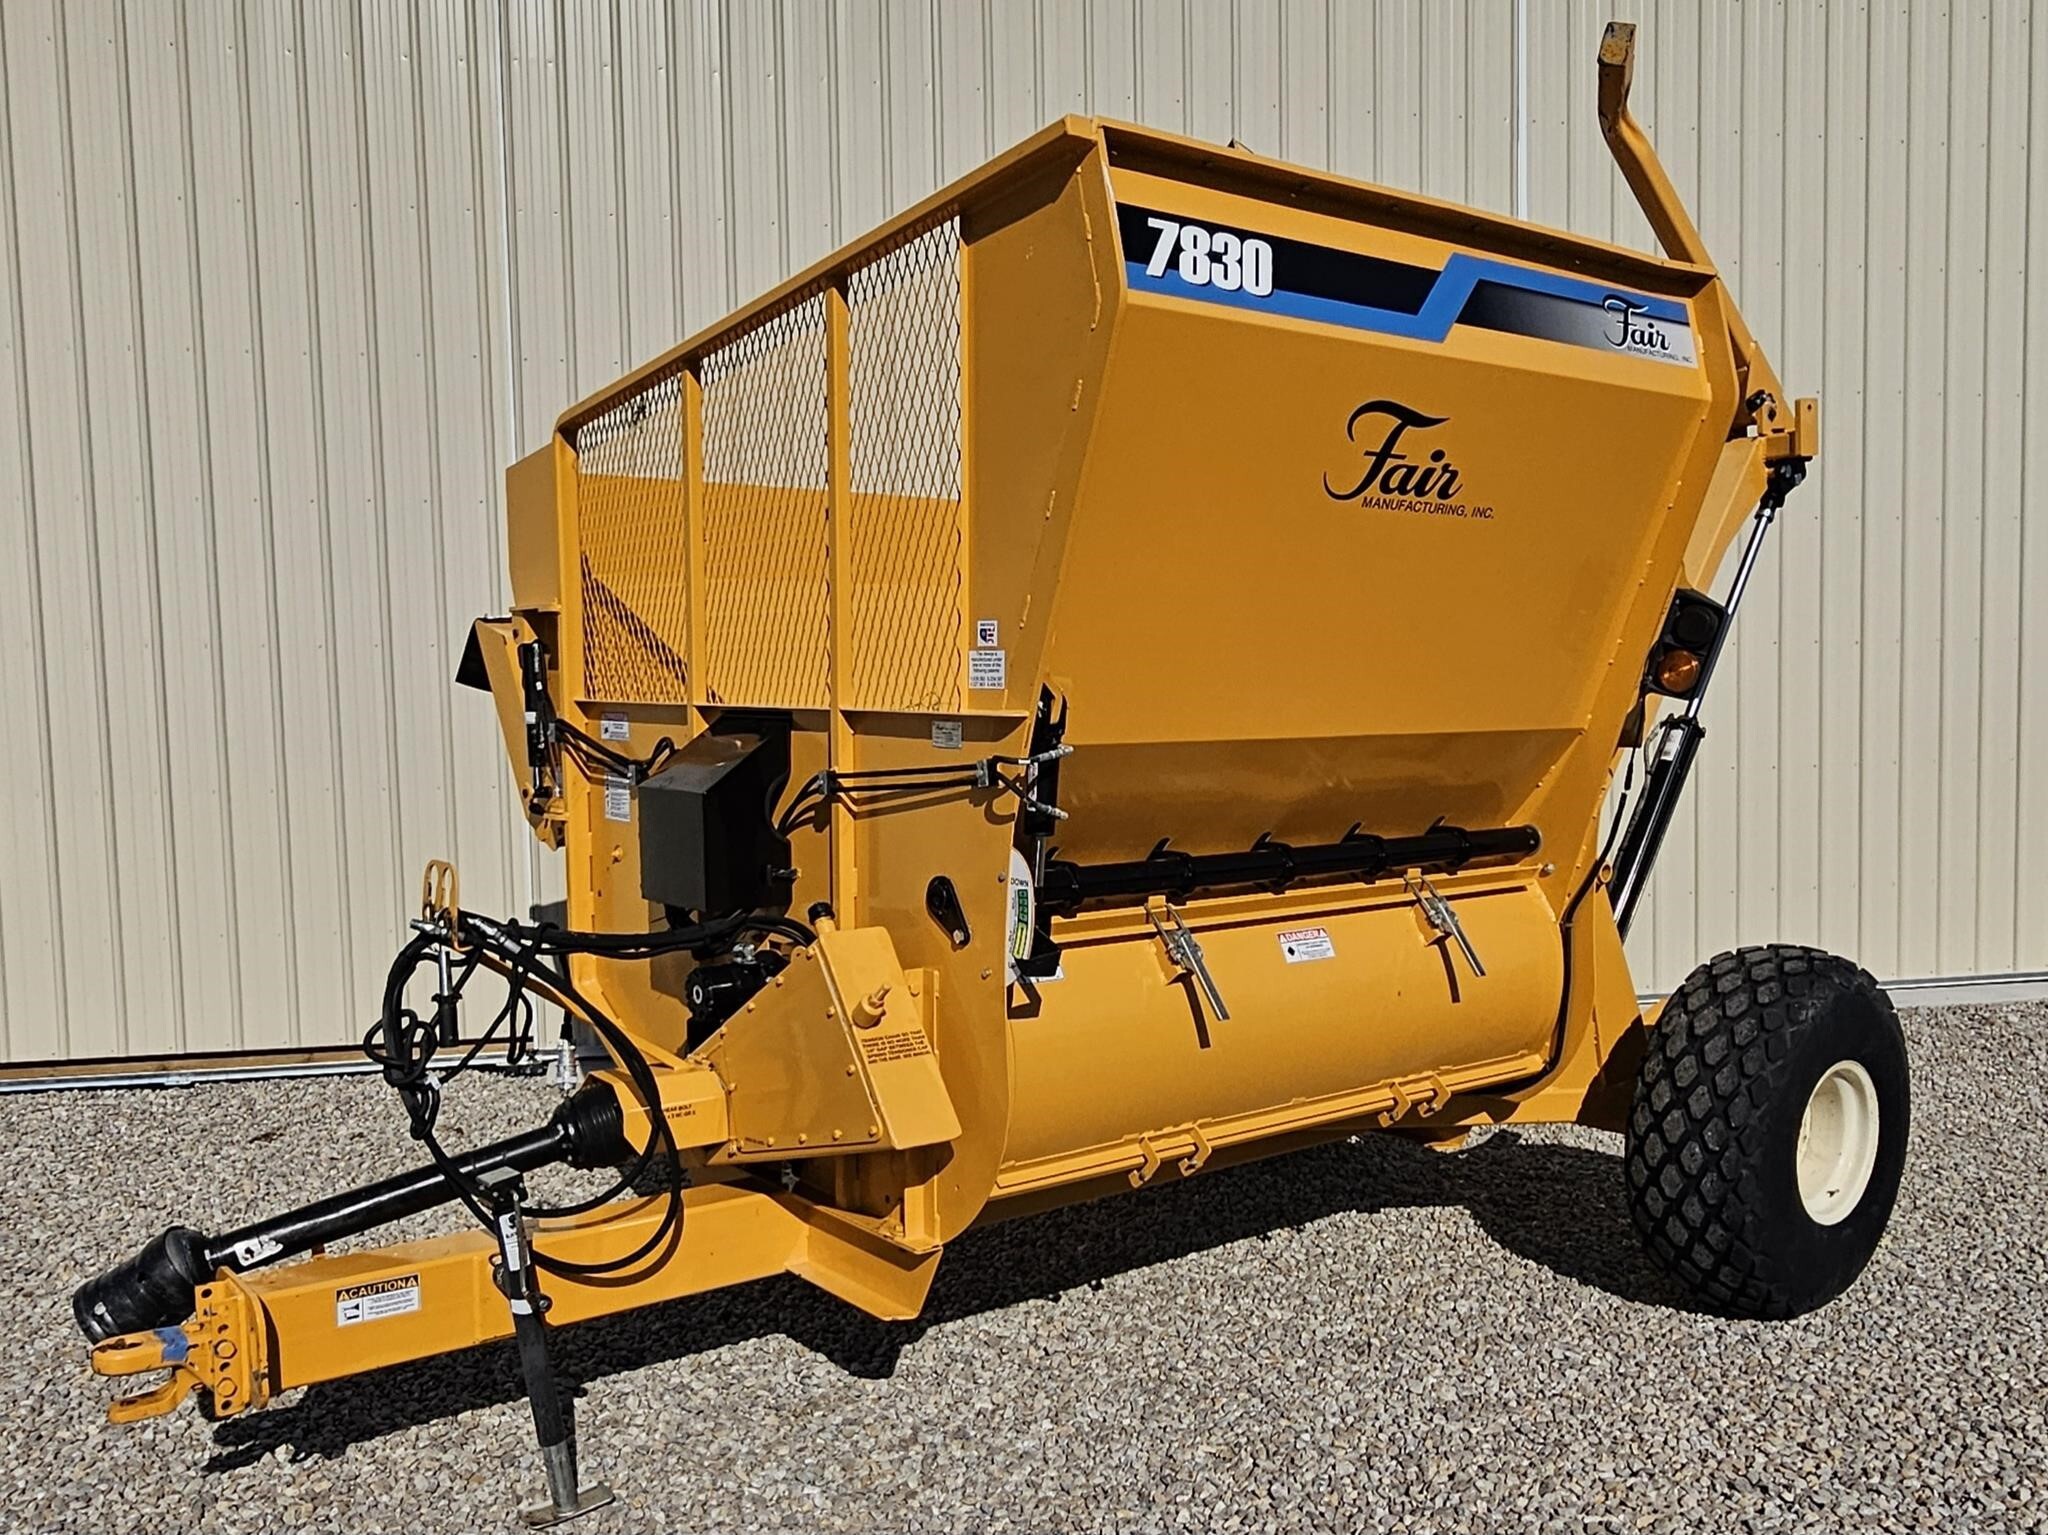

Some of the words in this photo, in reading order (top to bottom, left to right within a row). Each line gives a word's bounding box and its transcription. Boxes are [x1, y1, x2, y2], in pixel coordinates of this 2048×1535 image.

[1146, 217, 1273, 297] 7830
[1602, 294, 1671, 350] Fair
[1323, 399, 1464, 501] Fair
[1361, 496, 1468, 518] MANUFACTURING,
[1471, 506, 1495, 519] INC.
[1010, 877, 1028, 887] DOWN
[1285, 930, 1318, 942] DANGER
[348, 1280, 406, 1298] CAUTION
